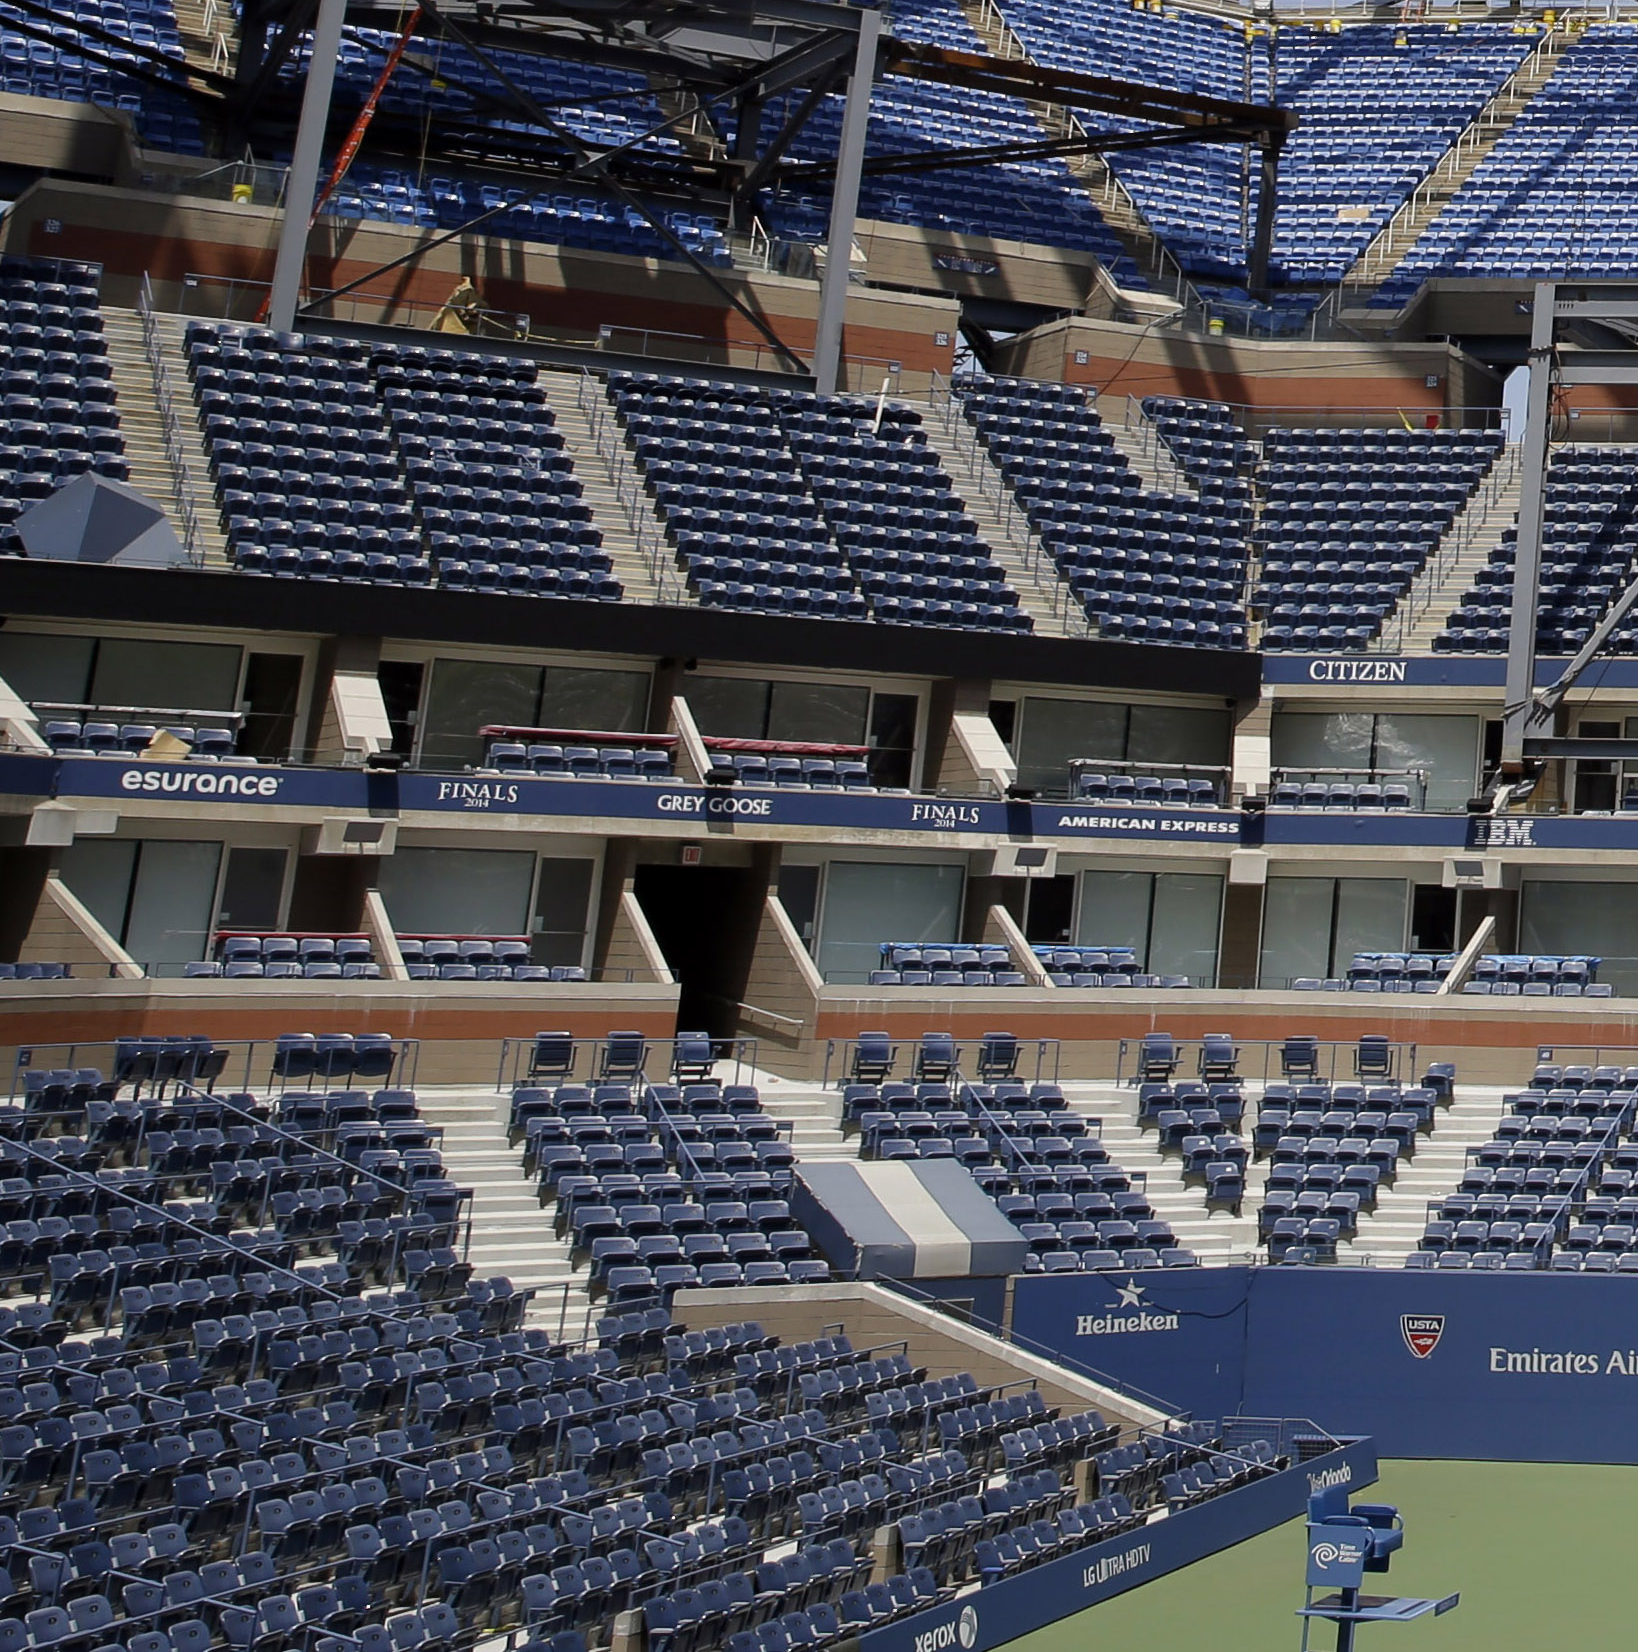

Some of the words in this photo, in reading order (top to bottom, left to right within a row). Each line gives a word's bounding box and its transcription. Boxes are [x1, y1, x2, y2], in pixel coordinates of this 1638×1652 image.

[1309, 659, 1407, 682] CITIZEN
[121, 768, 278, 797] esurance
[437, 781, 519, 804] FINALS
[464, 798, 490, 808] 2014
[657, 794, 705, 814] GREY
[708, 797, 773, 817] GOOSE
[911, 804, 980, 825] FINALS
[933, 819, 956, 829] 2014
[1058, 816, 1156, 832] AMERICAN
[1160, 819, 1240, 834] EXPRESS
[1474, 820, 1534, 846] IBM
[1076, 1311, 1179, 1336] Heineken
[1408, 1319, 1440, 1333] USTA
[1490, 1346, 1598, 1375] Emirates
[1126, 1543, 1151, 1569] HDTV
[915, 1620, 956, 1652] xerox
